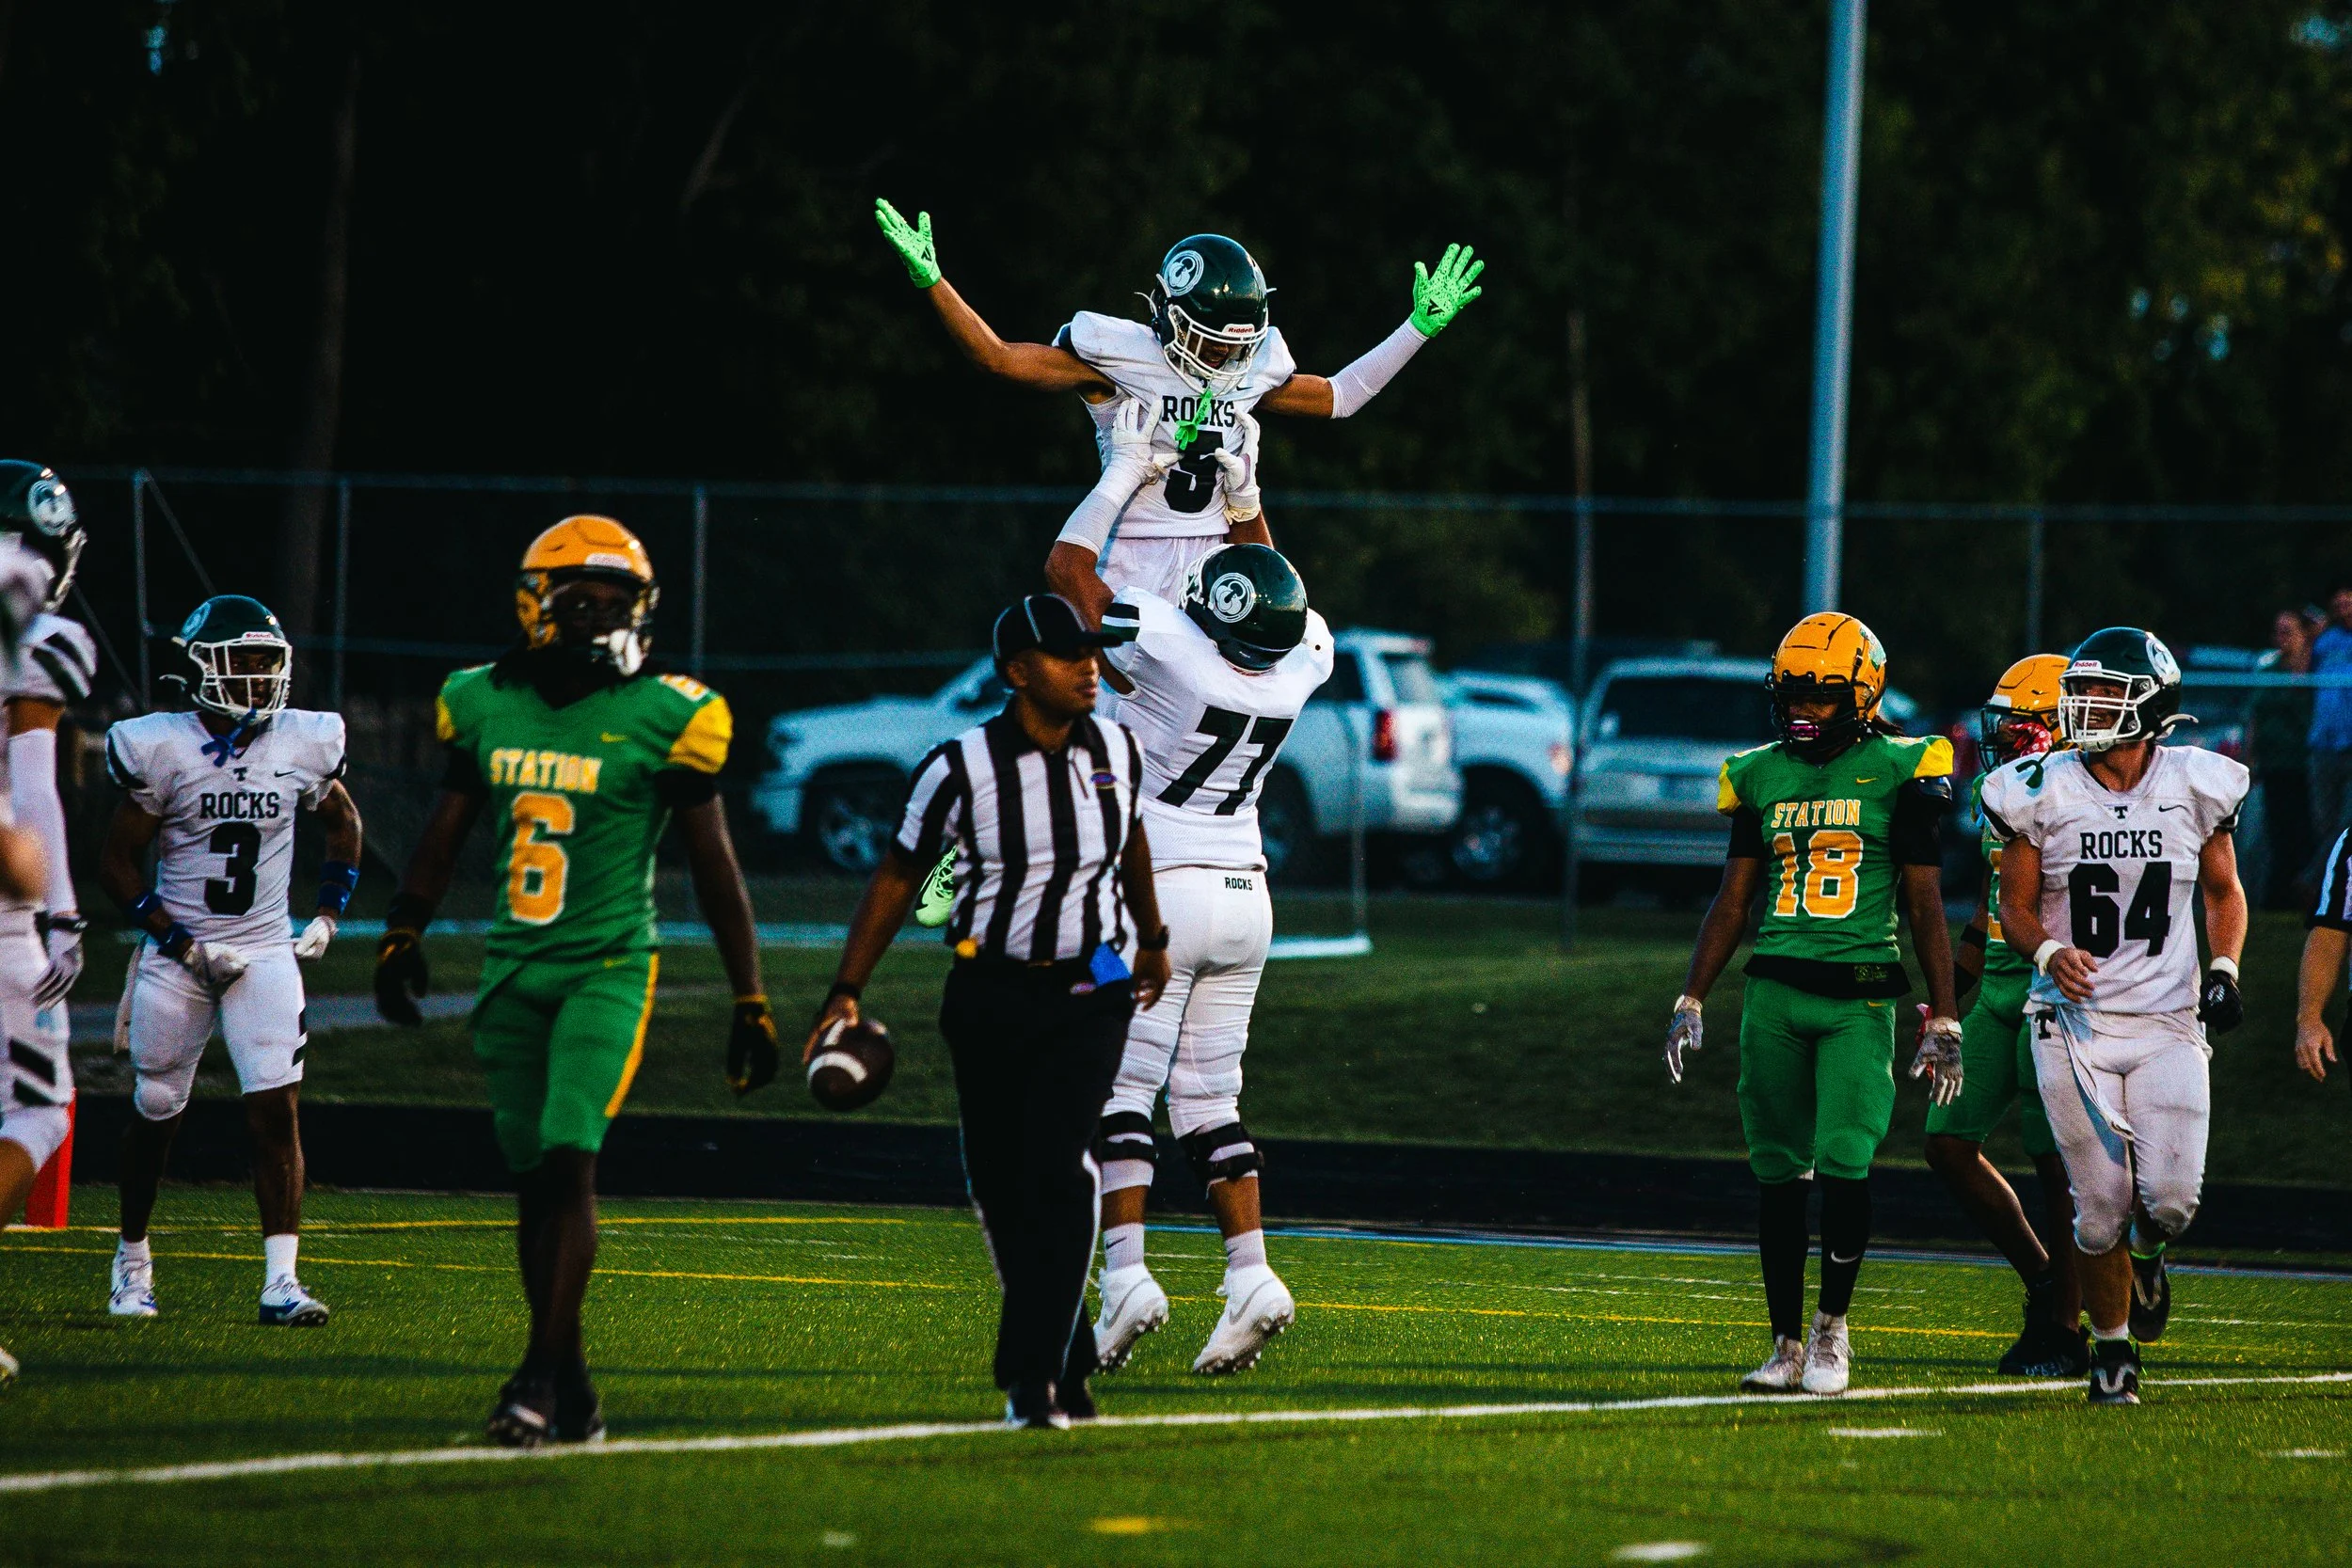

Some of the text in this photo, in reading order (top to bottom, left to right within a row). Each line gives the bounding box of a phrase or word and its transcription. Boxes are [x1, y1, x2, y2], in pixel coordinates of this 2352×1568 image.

[233, 767, 247, 782] T
[490, 749, 603, 794] STATION
[1155, 705, 1294, 816] 77
[199, 791, 280, 819] ROCKS
[1771, 799, 1862, 828] STATION
[2114, 806, 2128, 819] T
[508, 791, 576, 926] 6
[2079, 830, 2163, 860] ROCKS
[203, 821, 262, 916] 3
[1772, 829, 1864, 919] 18
[1224, 877, 1253, 891] ROCKS
[2068, 861, 2172, 958] 64
[2034, 1010, 2056, 1040] T
